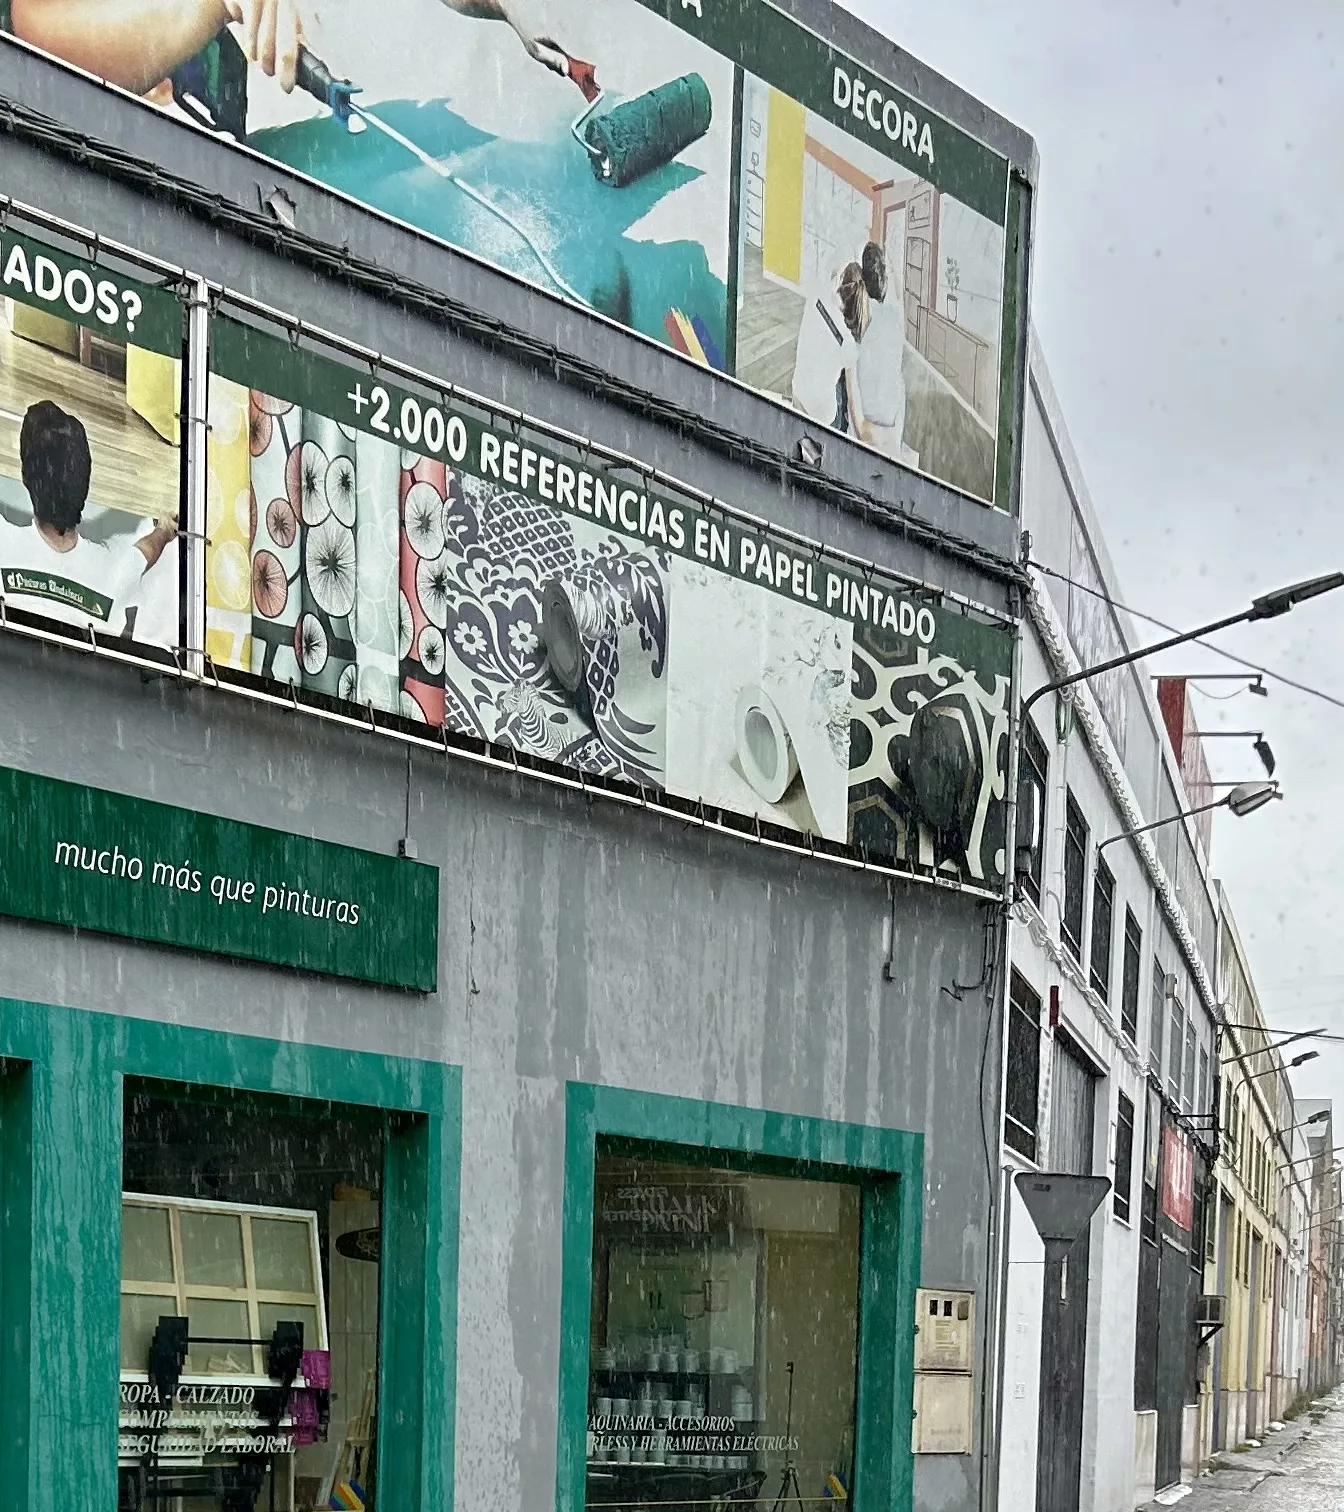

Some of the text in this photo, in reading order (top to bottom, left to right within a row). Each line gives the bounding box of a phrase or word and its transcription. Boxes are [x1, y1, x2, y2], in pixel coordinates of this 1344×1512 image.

[833, 67, 934, 163] DECORA
[347, 383, 936, 644] +2.000 REFERENCIAS EN PAPEL PINTADO
[54, 841, 360, 925] mucho más que pinturas
[176, 1386, 255, 1405] CALZADO
[587, 1415, 655, 1435] AQUINARIA
[665, 1415, 736, 1432] ACCESORIOS
[220, 1436, 297, 1454] LABORAL
[588, 1435, 628, 1452] RLESS
[641, 1435, 730, 1452] HERRAMIENTAS
[733, 1432, 800, 1451] ELÉCTRICAS
